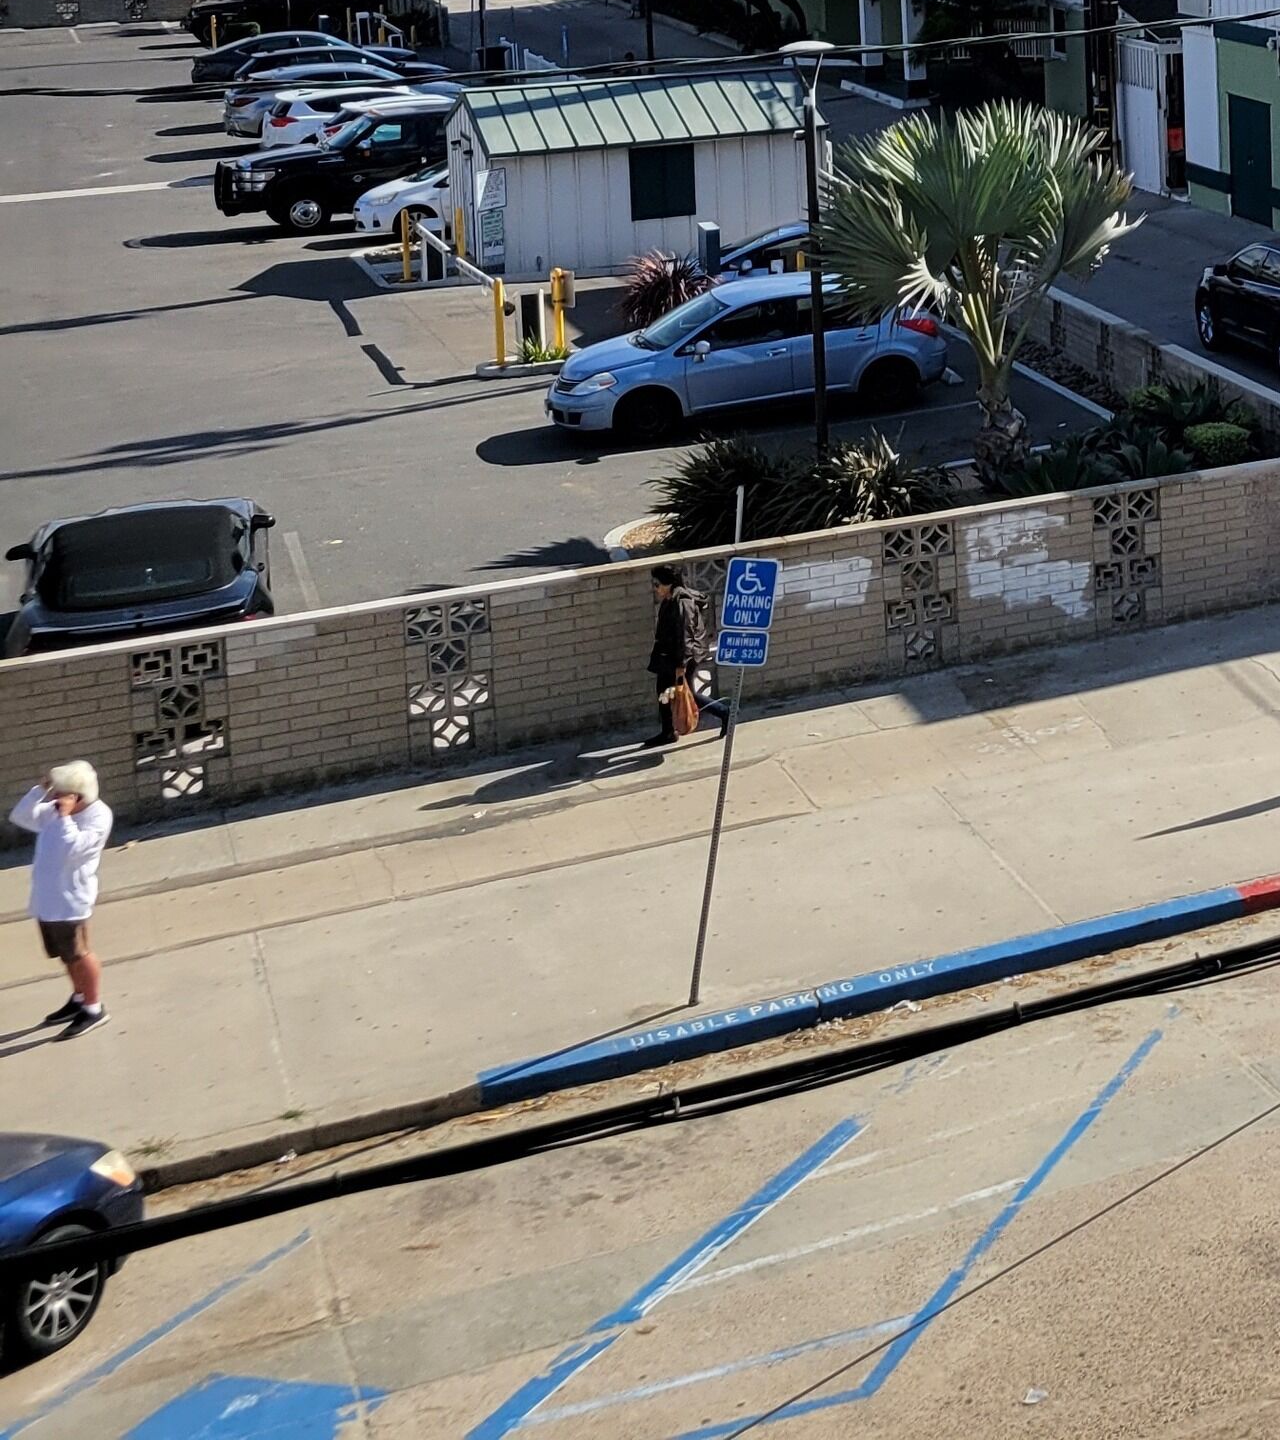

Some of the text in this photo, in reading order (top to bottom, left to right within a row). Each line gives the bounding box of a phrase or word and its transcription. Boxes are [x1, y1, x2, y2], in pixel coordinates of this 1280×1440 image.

[727, 594, 771, 609] PARKING
[734, 610, 761, 625] ONLY
[727, 636, 760, 647] MINIMUM
[741, 649, 764, 659] $250
[631, 962, 935, 1048] DISABLE PARKING ONLY
